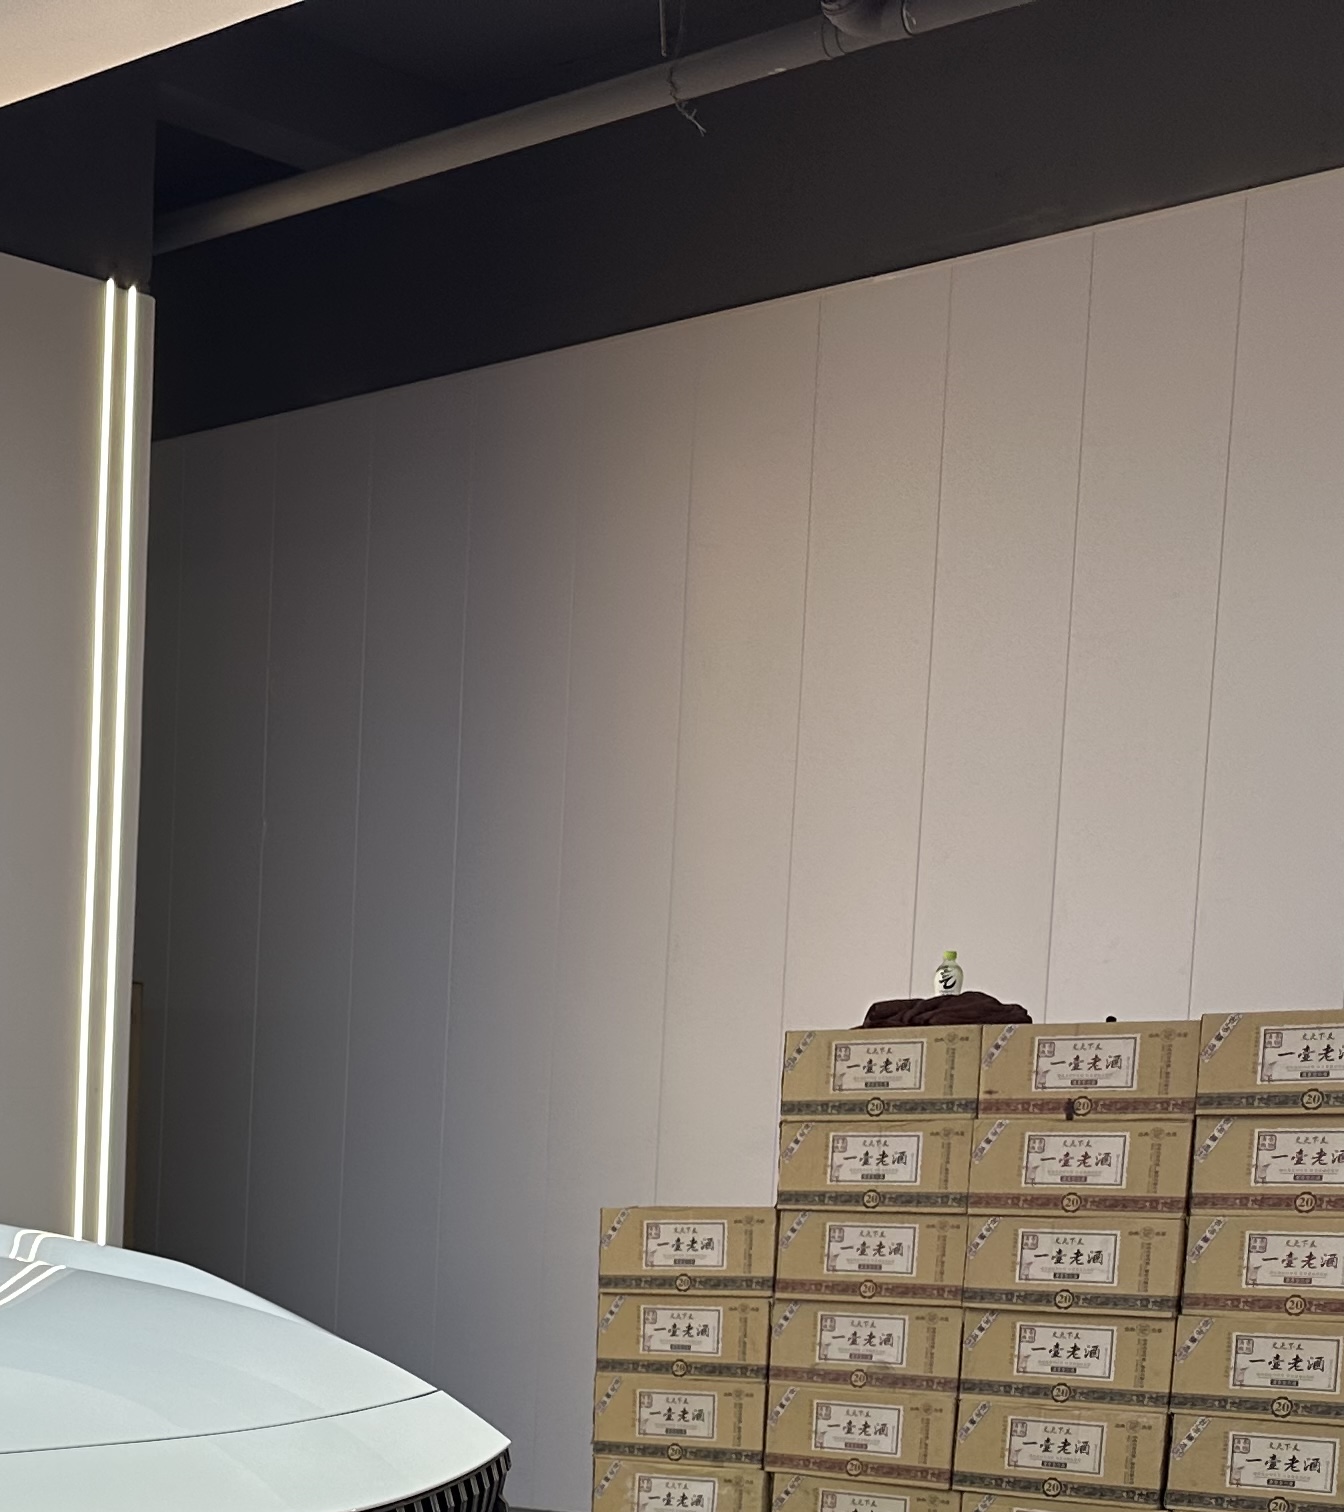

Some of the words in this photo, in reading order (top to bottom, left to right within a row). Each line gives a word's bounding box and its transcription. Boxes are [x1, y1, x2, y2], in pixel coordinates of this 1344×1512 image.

[1305, 1094, 1320, 1104] 20
[1075, 1100, 1089, 1110] 20
[1064, 1197, 1078, 1207] 20
[1298, 1197, 1312, 1207] 20
[1056, 1294, 1070, 1304] 20
[1288, 1300, 1302, 1310] 20
[1053, 1388, 1067, 1398] 20
[1275, 1401, 1289, 1411] 20
[1045, 1482, 1059, 1492] 20
[1271, 1501, 1285, 1511] 20
